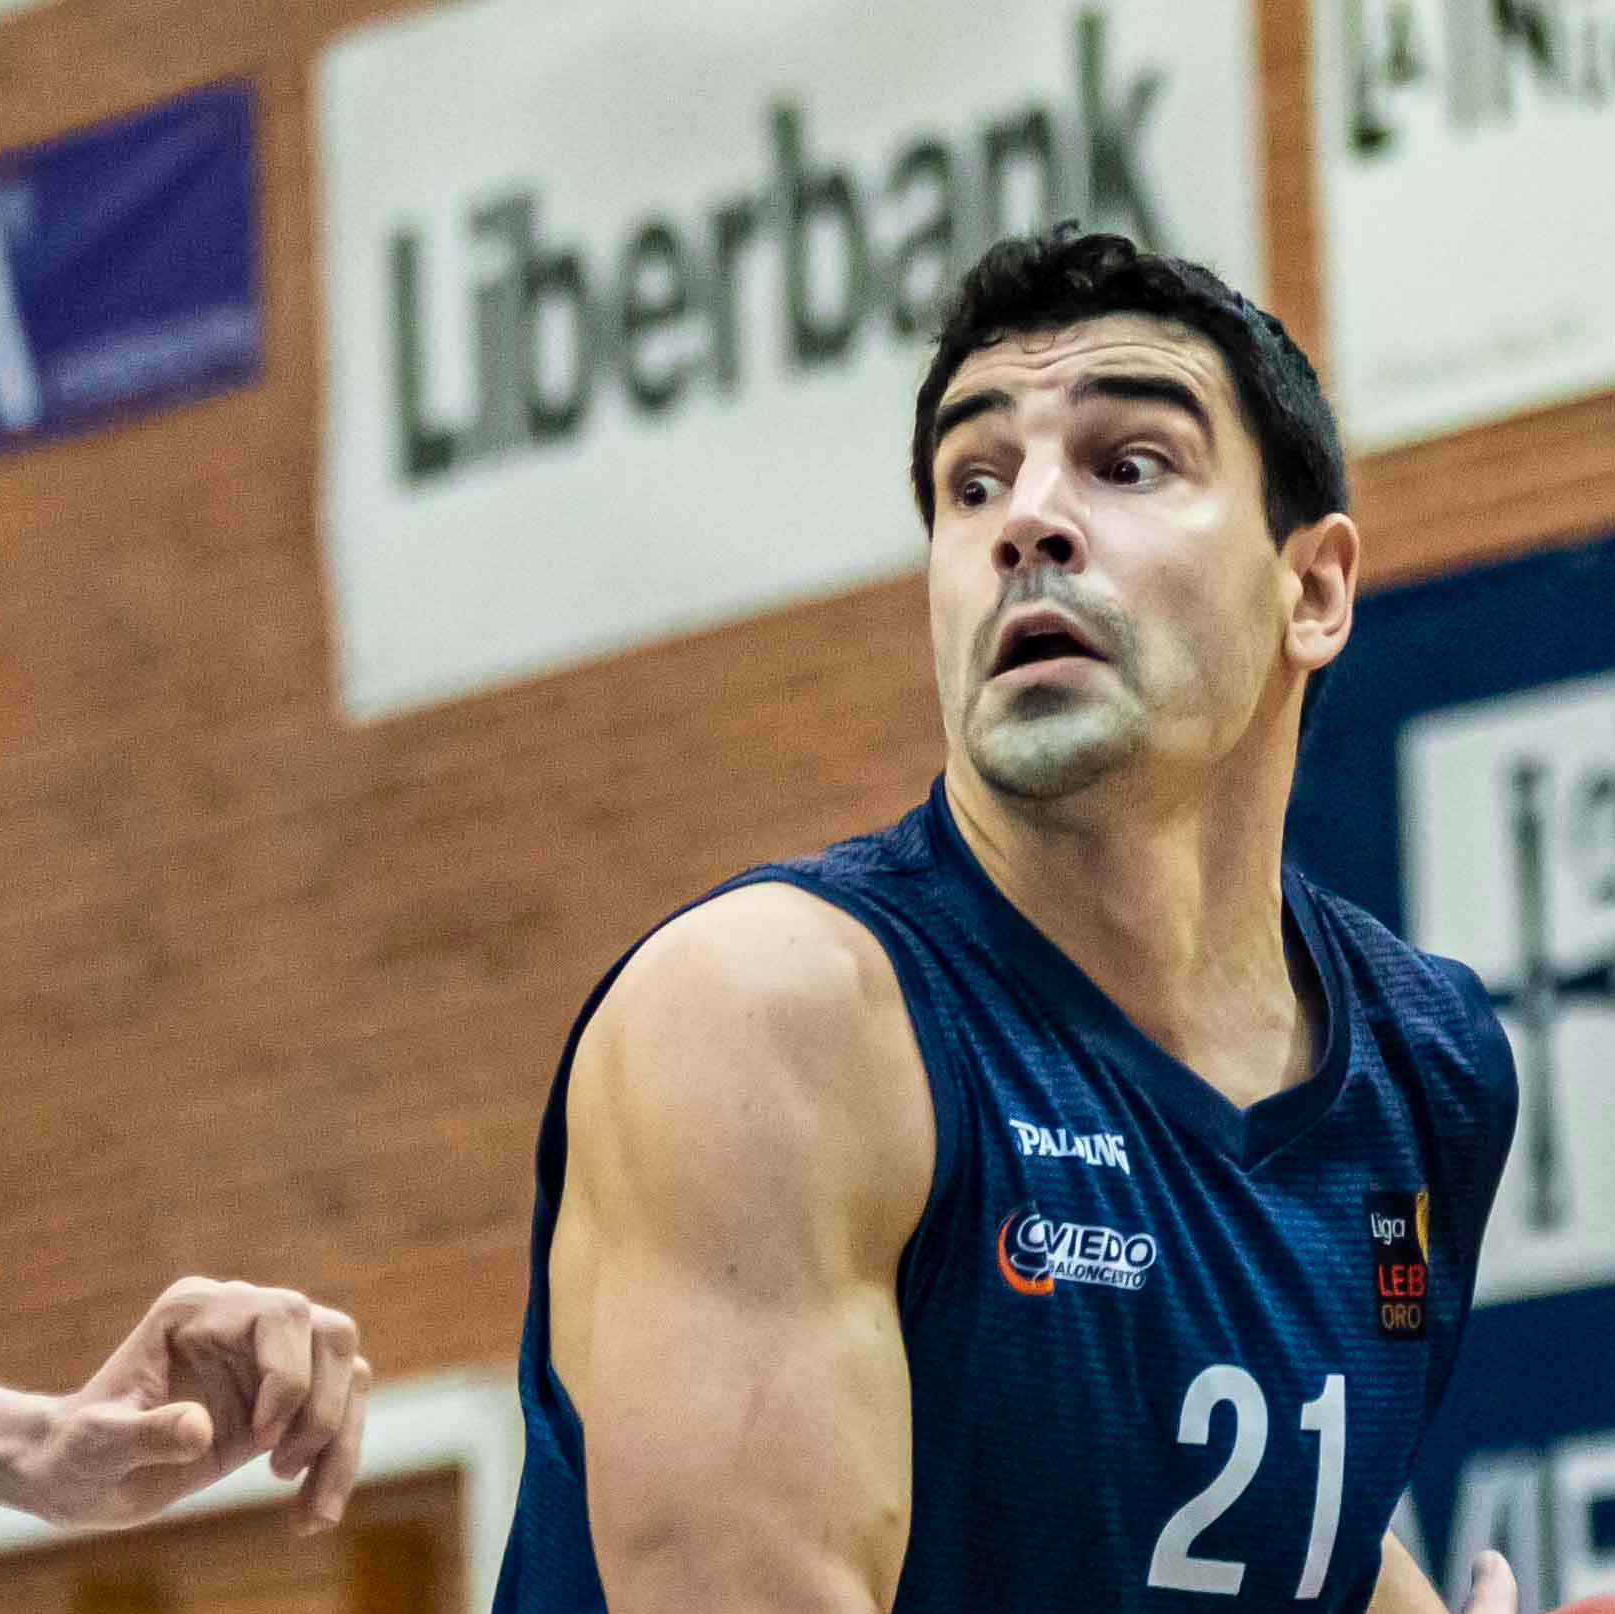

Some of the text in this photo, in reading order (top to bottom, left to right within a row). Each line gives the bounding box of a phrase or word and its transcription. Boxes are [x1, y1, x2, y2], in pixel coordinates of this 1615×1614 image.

[386, 4, 1168, 486] Liberbank
[1018, 1214, 1156, 1270] OVIEDO
[1370, 1210, 1406, 1246] Liga
[1378, 1263, 1427, 1297] LEB
[1381, 1303, 1422, 1330] ORO
[1146, 1363, 1346, 1600] 21
